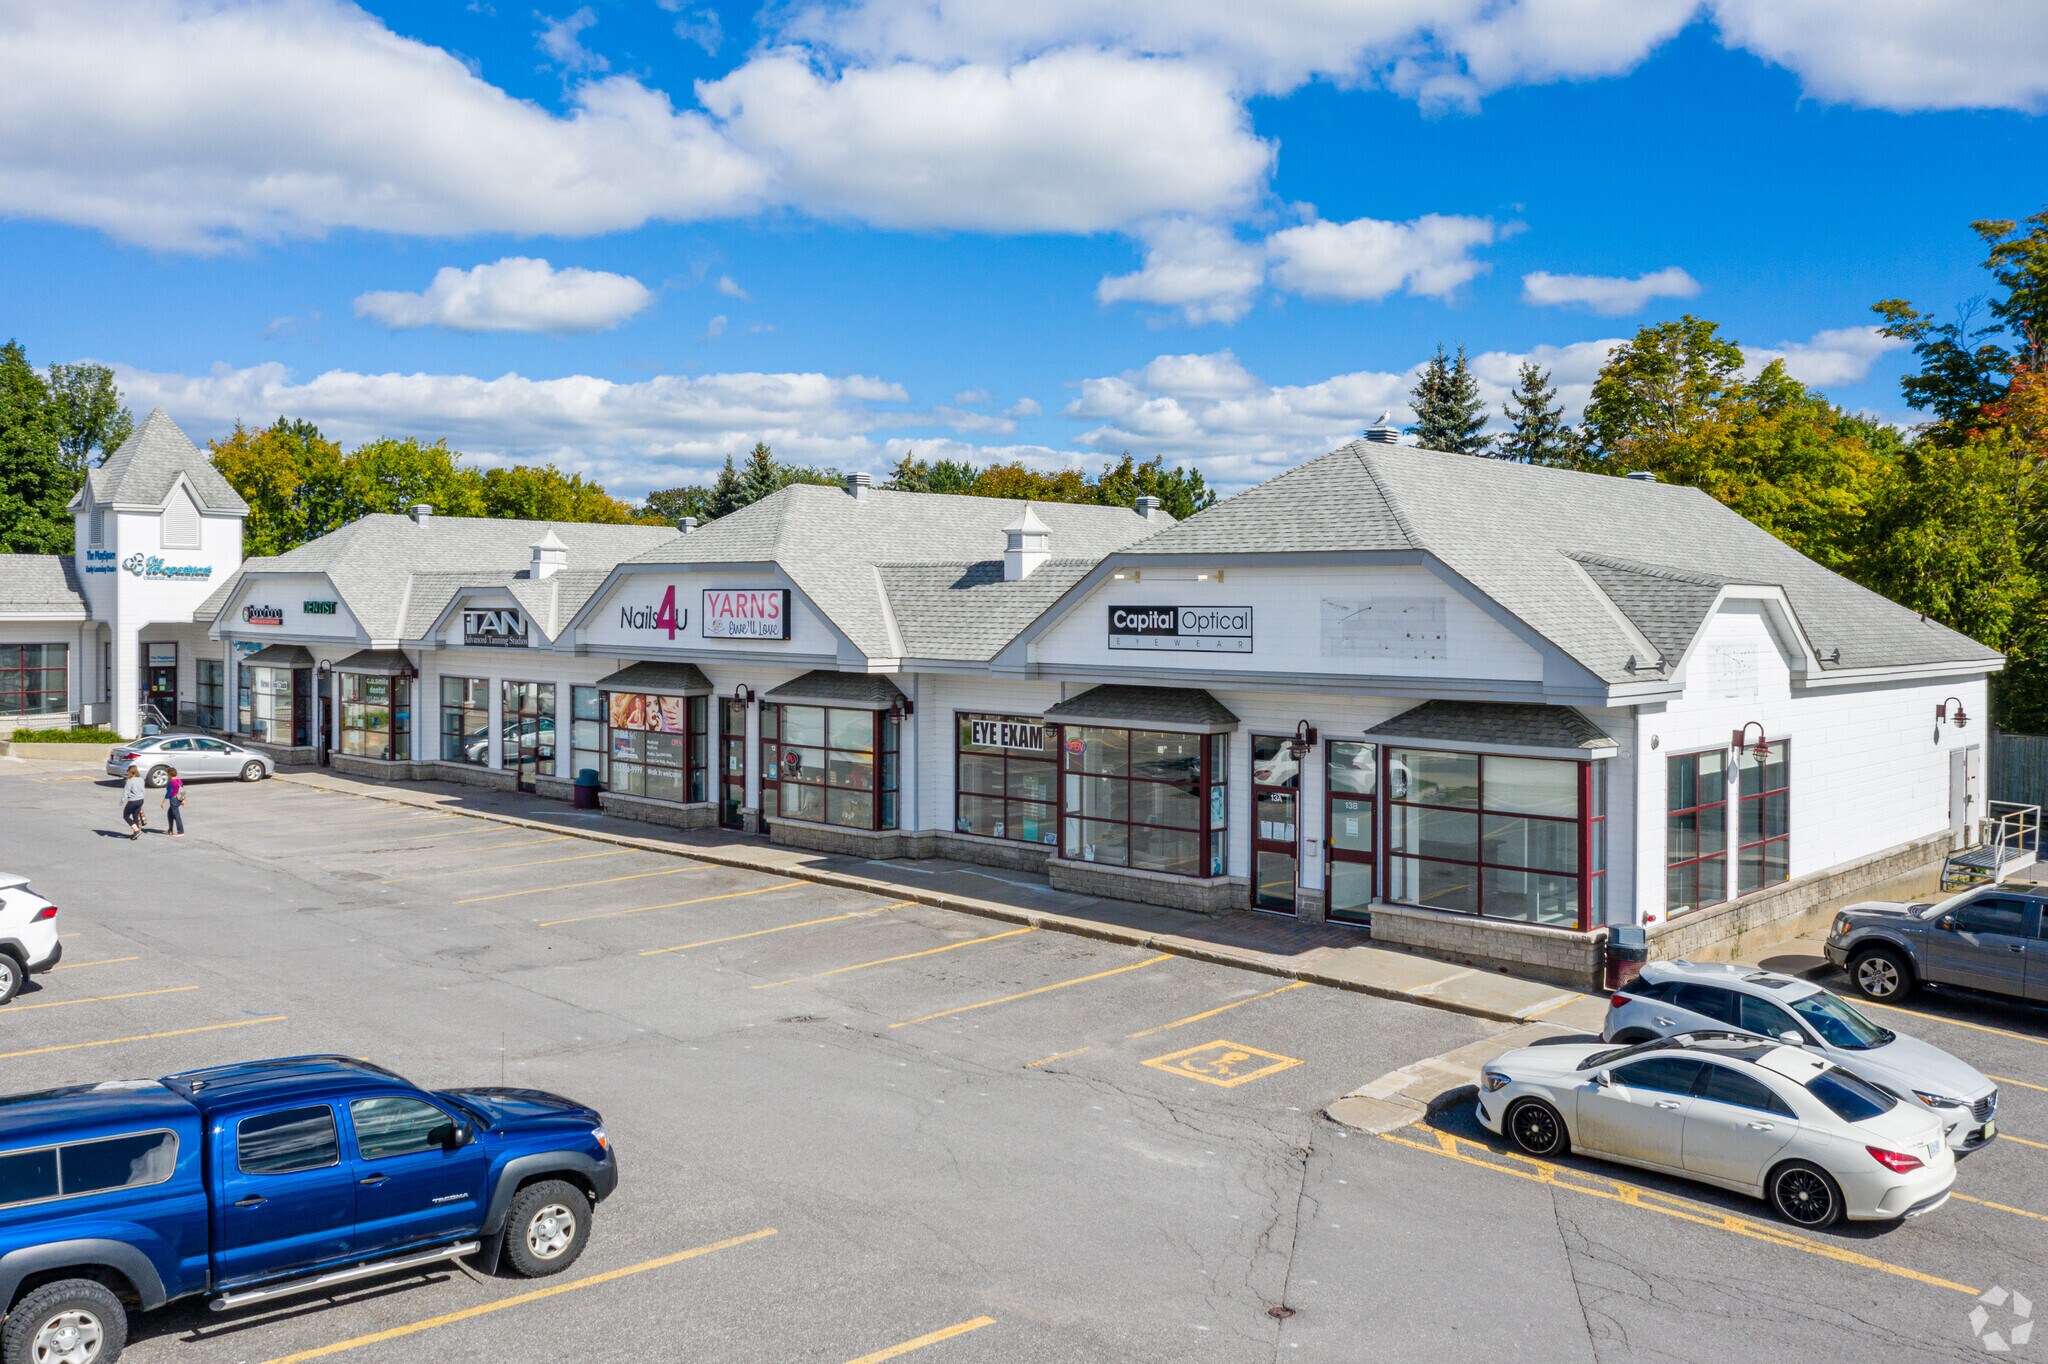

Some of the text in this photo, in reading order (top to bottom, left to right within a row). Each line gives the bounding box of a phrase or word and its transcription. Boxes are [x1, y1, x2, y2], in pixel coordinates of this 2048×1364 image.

[304, 601, 337, 614] DENTIST
[708, 593, 779, 619] YARNS
[729, 620, 779, 635] Ewe'll Love
[1114, 610, 1247, 632] Capital Optical
[465, 635, 528, 647] Advanced Tanning Studios
[973, 721, 1042, 749] EYE EXAM
[1066, 741, 1083, 752] OPEN
[1270, 794, 1283, 802] 13A
[1344, 802, 1358, 810] 13B
